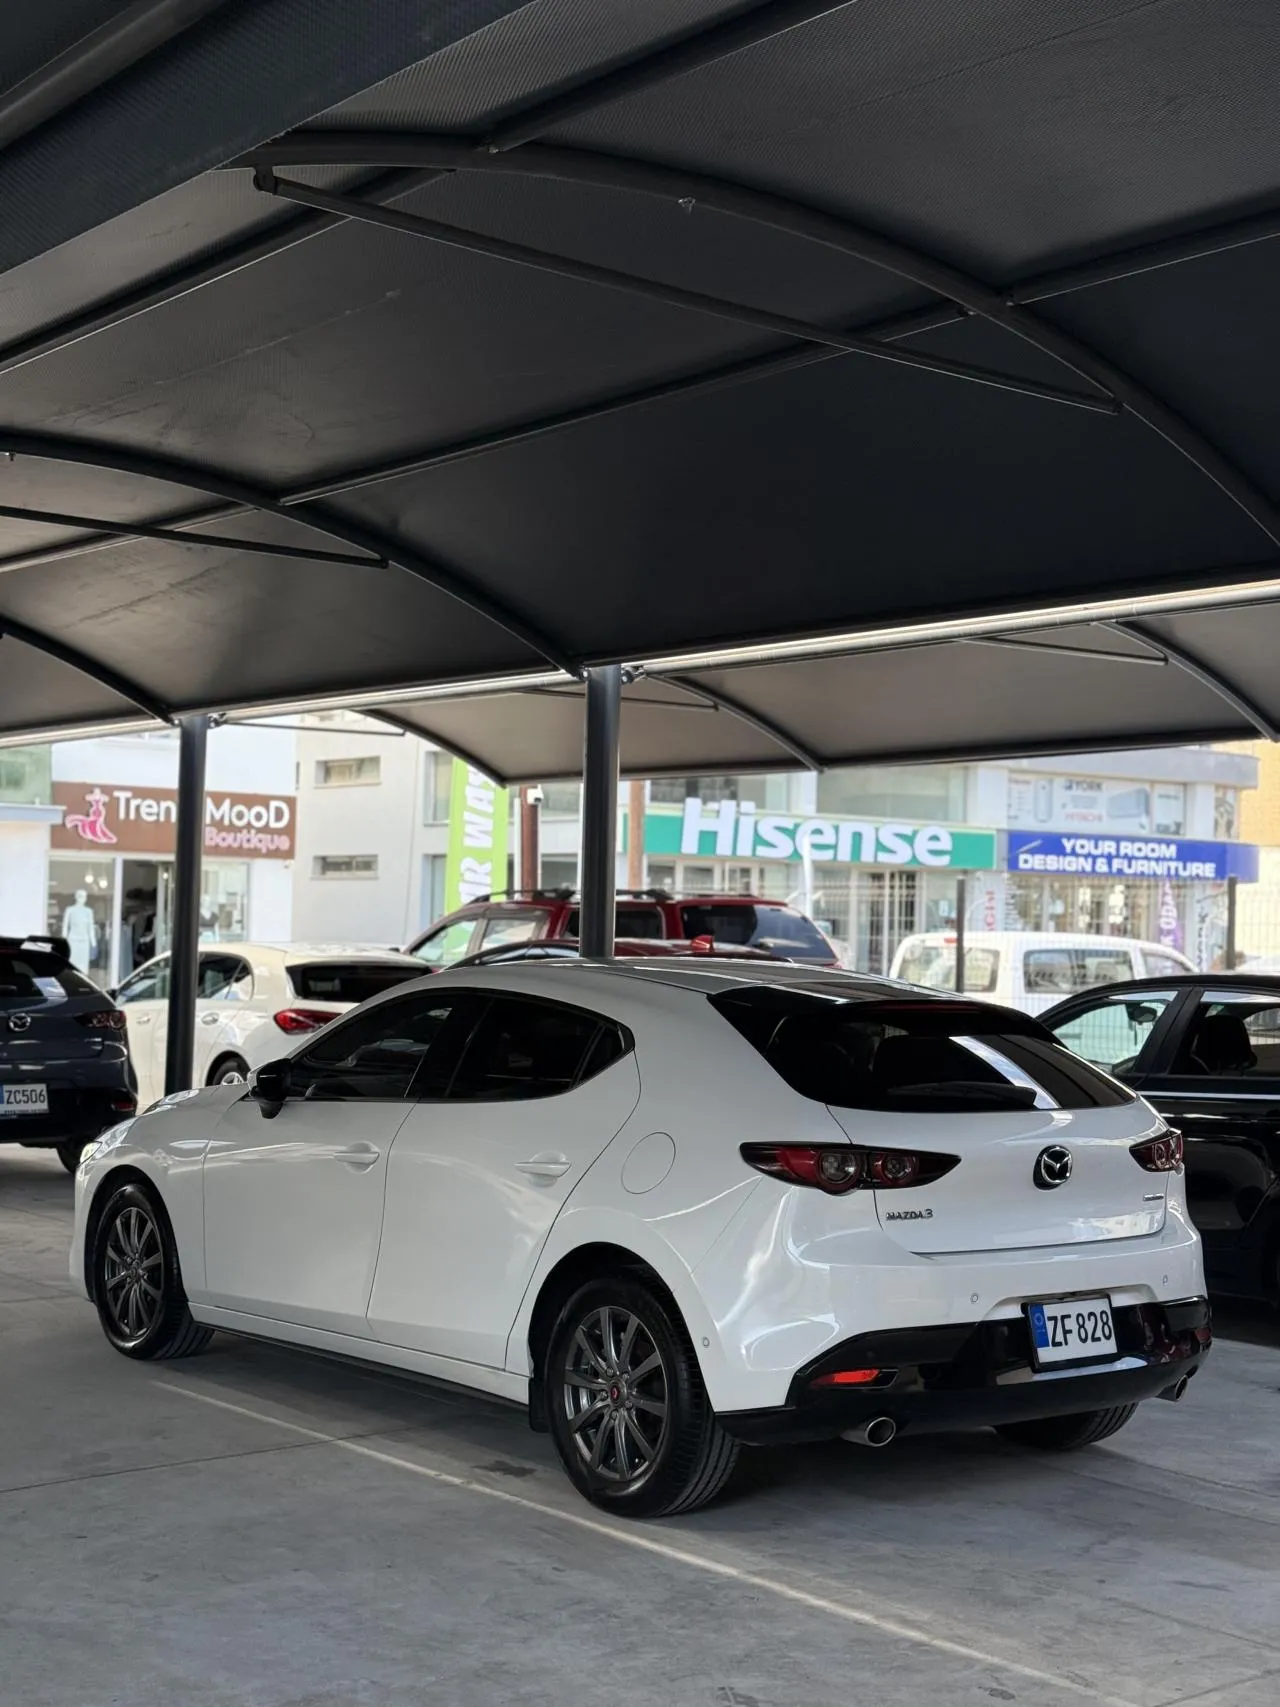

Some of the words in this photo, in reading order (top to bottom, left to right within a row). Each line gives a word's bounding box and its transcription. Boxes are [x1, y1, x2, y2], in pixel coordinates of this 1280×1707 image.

[113, 791, 176, 821] Tren
[205, 828, 290, 854] Boutique
[681, 797, 953, 868] Hisense
[1061, 838, 1115, 856] YOUR
[1119, 841, 1177, 859] ROOM
[1018, 854, 1092, 872] DESIGN
[1095, 858, 1108, 872] &
[1112, 858, 1216, 878] FURNITURE
[5, 1088, 46, 1105] ZC506
